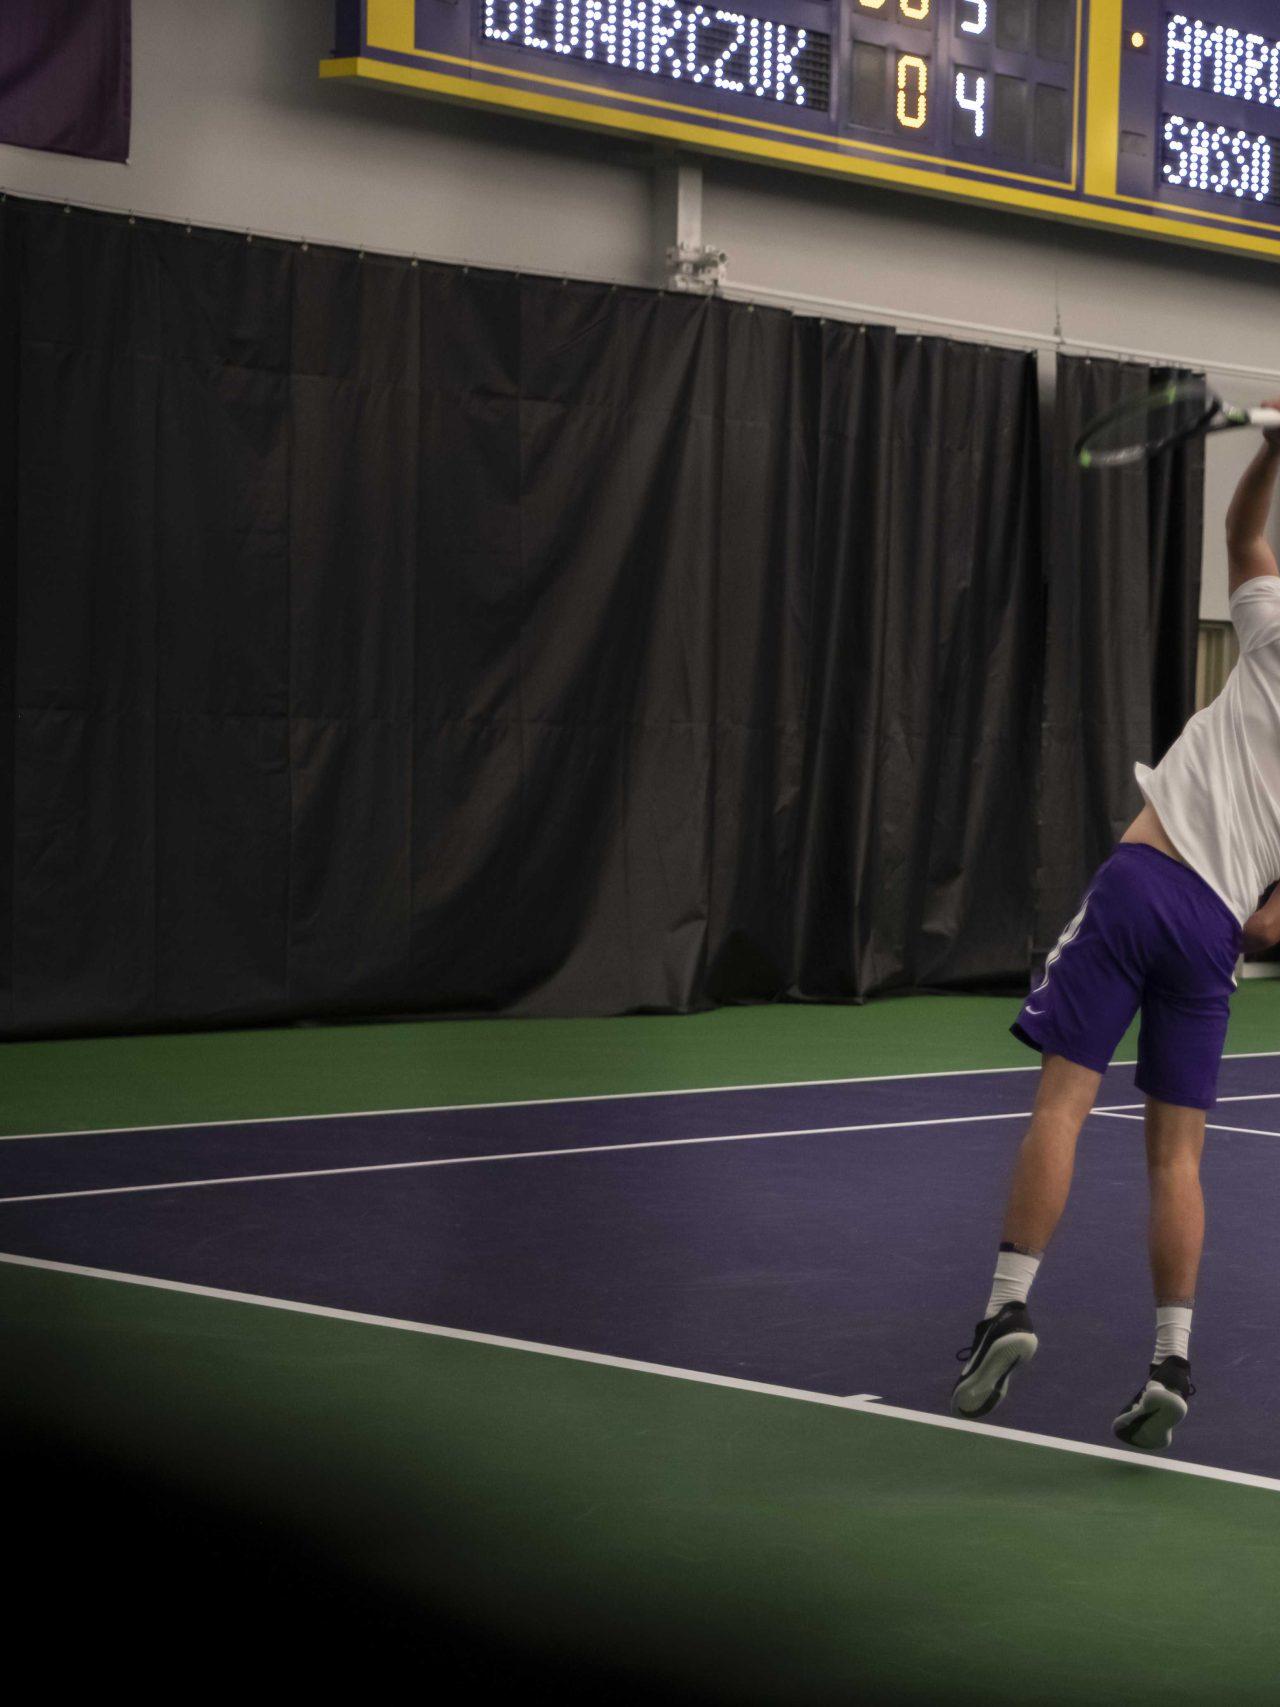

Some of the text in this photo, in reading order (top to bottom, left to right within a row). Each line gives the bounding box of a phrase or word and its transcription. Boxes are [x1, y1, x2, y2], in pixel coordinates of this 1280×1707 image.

[896, 55, 986, 137] 0 4
[1163, 115, 1271, 201] SASSO
